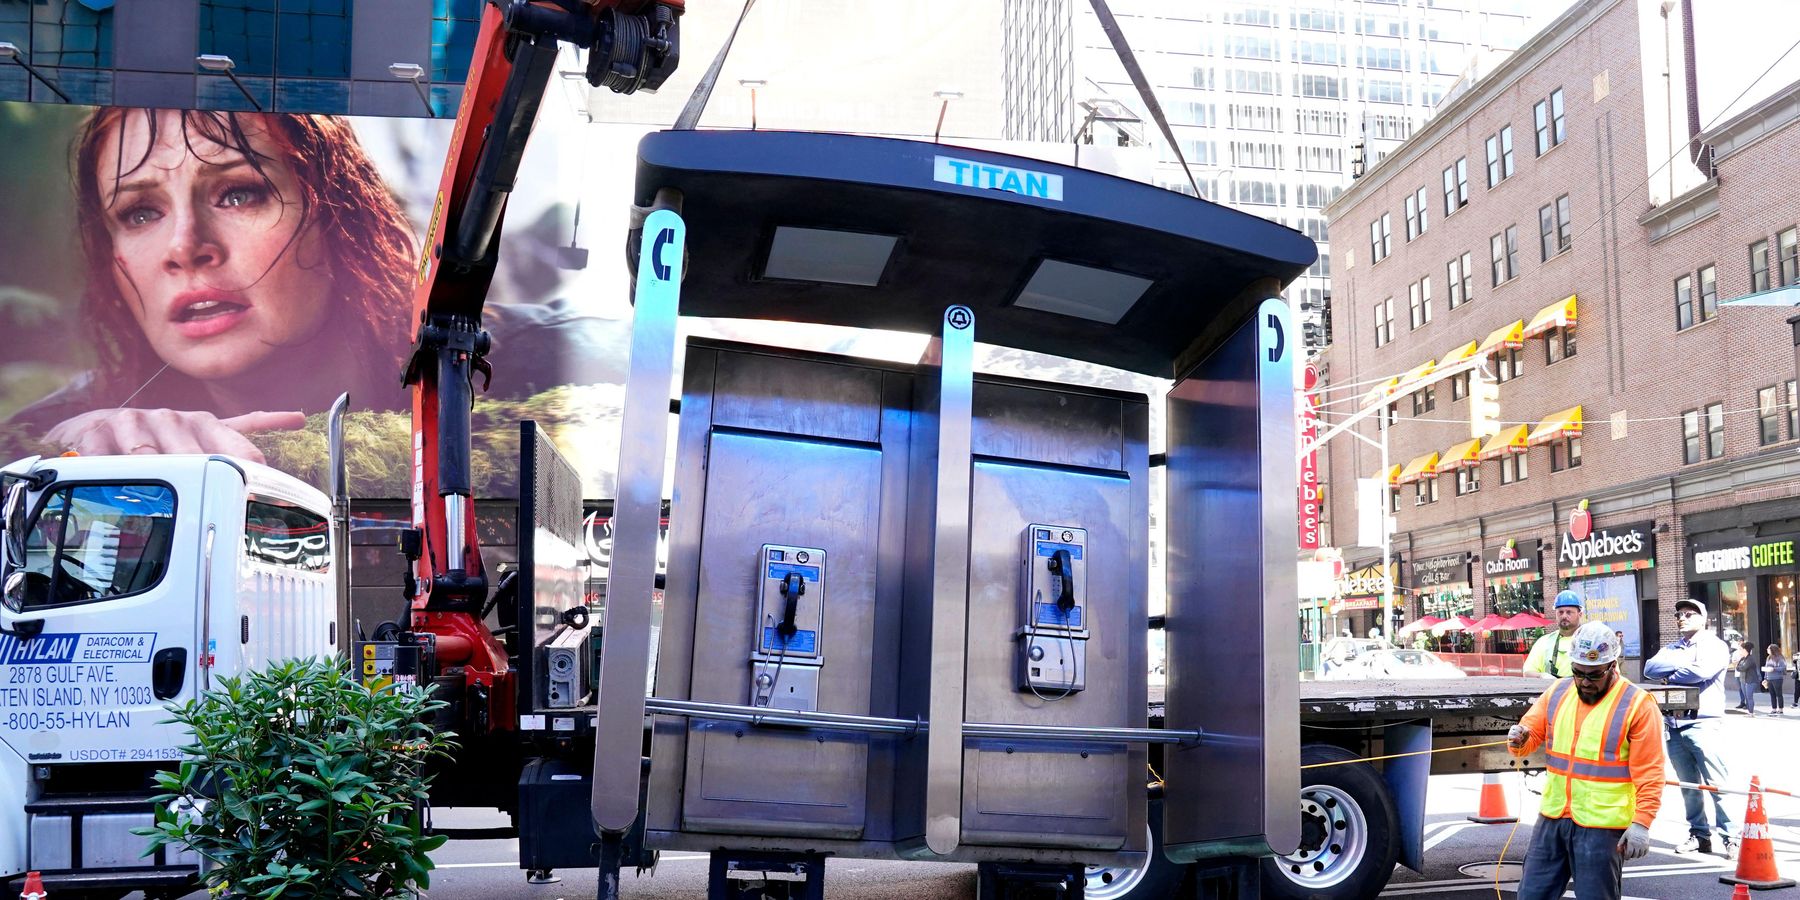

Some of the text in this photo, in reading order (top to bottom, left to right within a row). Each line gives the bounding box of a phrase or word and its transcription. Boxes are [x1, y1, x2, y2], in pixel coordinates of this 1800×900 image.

[948, 160, 1049, 199] TITAN
[1559, 530, 1643, 567] Applebee's
[1695, 541, 1794, 574] GREGORYS COFFEE
[1486, 557, 1529, 574] Club Room
[12, 637, 74, 660] HYLAN
[86, 636, 145, 647] DATACOM &
[83, 649, 144, 660] ELECTRICAL
[9, 665, 118, 684] 2878 GULF AVE.
[0, 686, 152, 707] TEN ISLAND, NY 10303
[70, 750, 127, 761] USDOT#
[130, 748, 185, 760] 2941534
